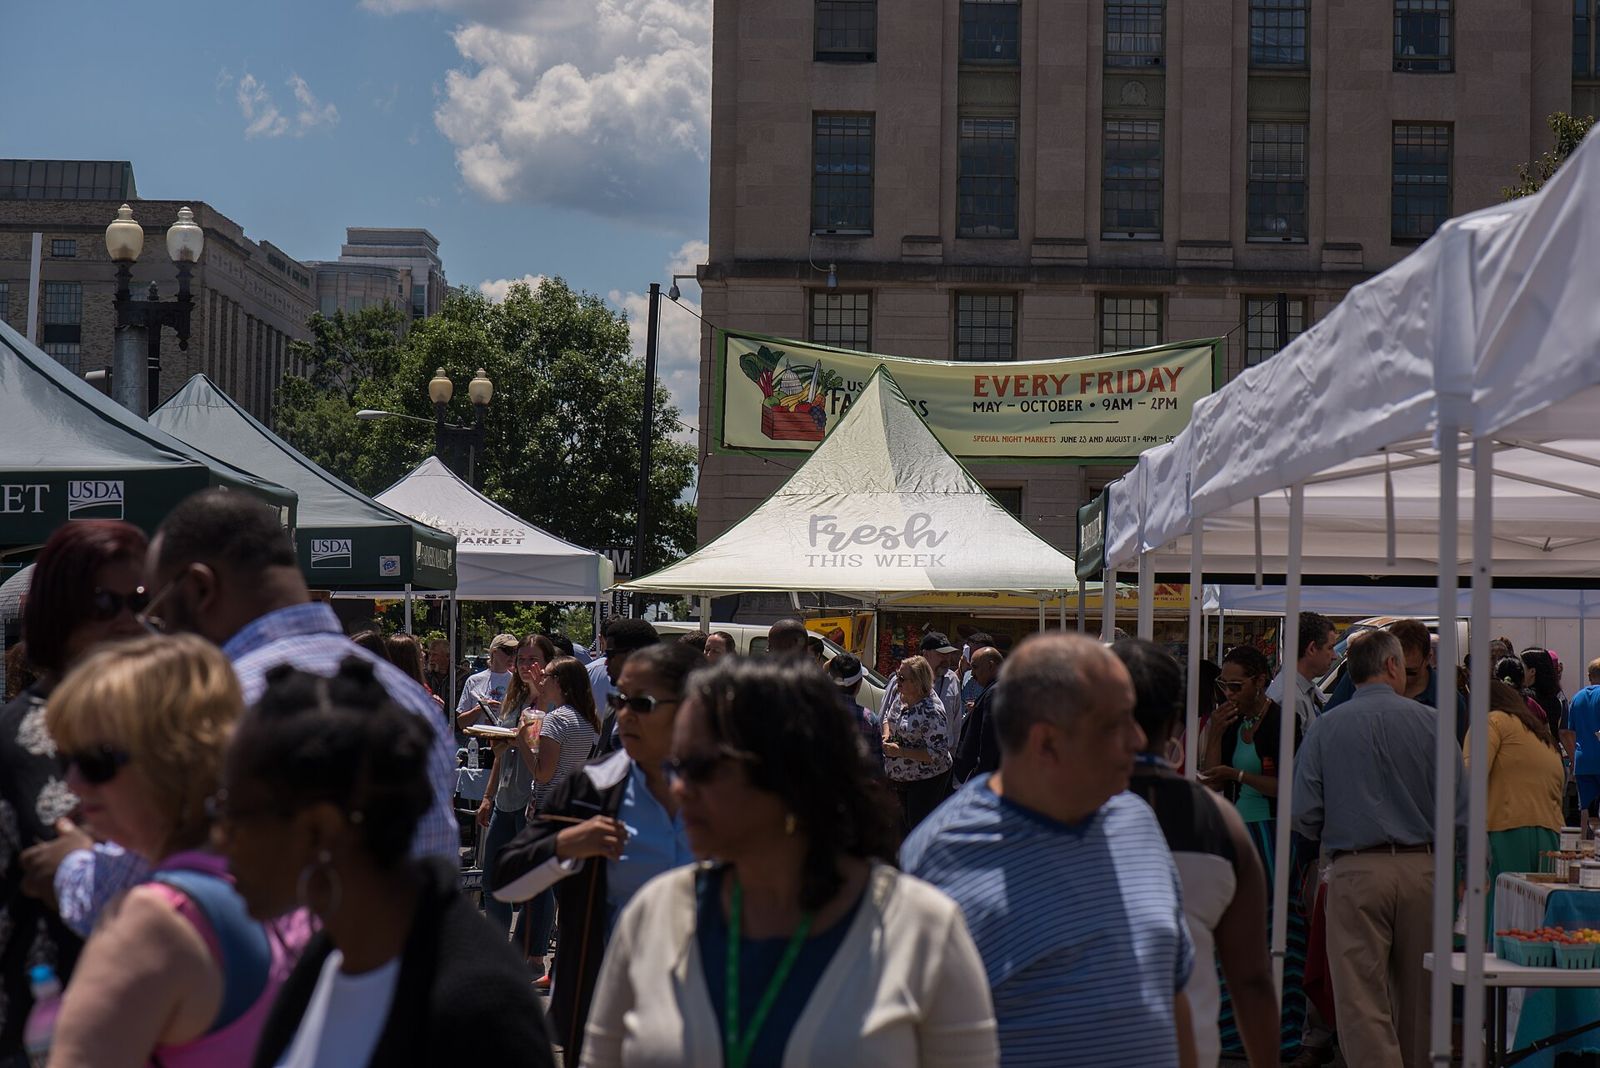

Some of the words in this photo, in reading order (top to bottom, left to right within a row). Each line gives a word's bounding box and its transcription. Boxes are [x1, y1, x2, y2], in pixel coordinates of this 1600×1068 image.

[847, 380, 863, 392] US
[973, 374, 1070, 398] EVERY
[1079, 366, 1185, 395] FRIDAY
[972, 401, 1003, 413] MAY
[1020, 399, 1083, 413] OCTOBER
[1102, 398, 1133, 411] 9AM
[1150, 397, 1178, 410] 2PM
[69, 482, 122, 499] USDA
[446, 527, 526, 537] ARMERS
[808, 512, 950, 552] Fresh
[312, 540, 351, 552] USDA
[804, 554, 863, 568] THIS
[874, 554, 946, 568] WEEK
